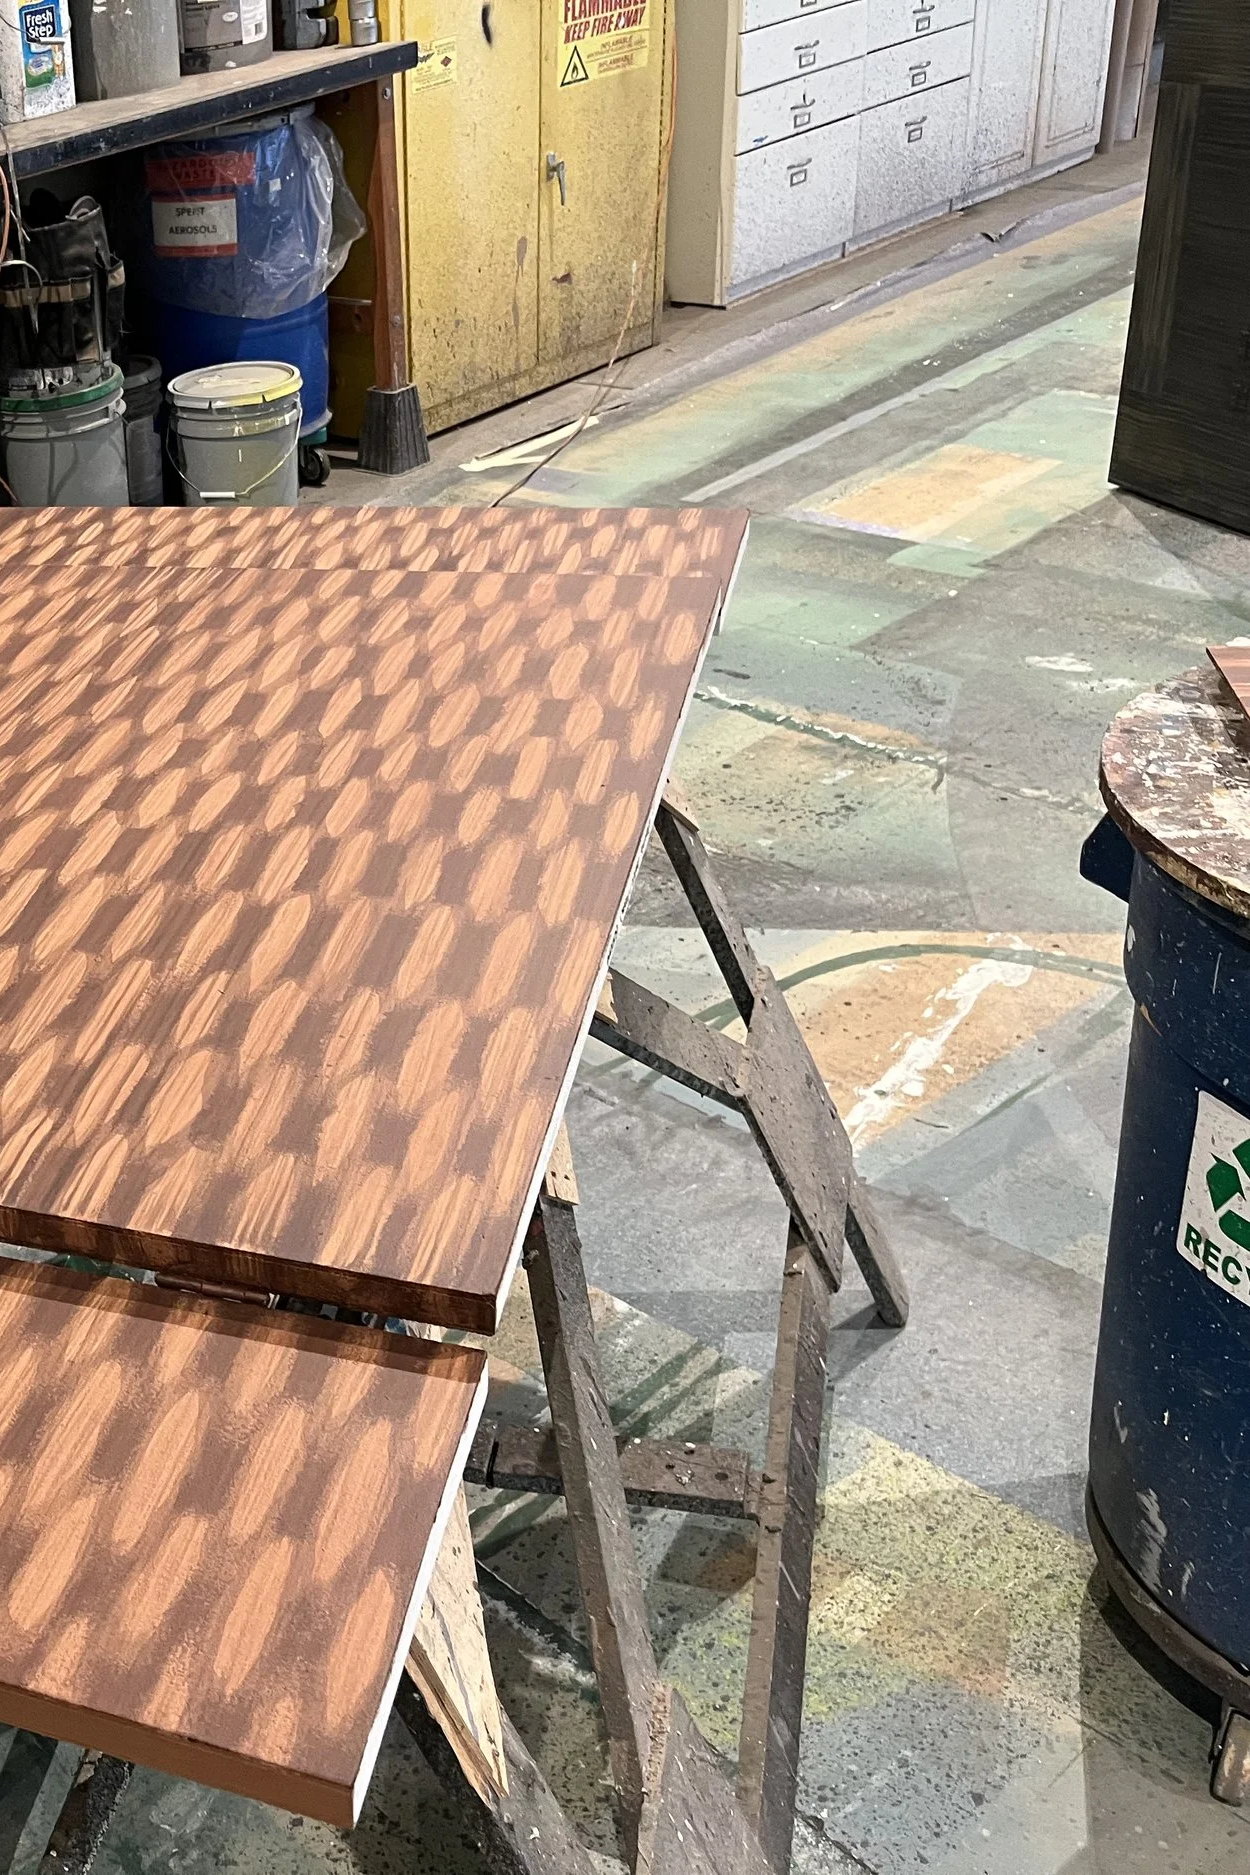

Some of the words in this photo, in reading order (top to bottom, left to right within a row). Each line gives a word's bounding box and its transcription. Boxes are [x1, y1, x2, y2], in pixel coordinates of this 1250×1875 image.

[26, 10, 53, 28] Fresh
[564, 0, 646, 23] FLAMM
[564, 21, 590, 44] KEEP
[591, 14, 614, 37] FIRE
[614, 6, 646, 31] AWAY
[175, 206, 205, 217] SPENT
[169, 224, 218, 235] AEROSOLS
